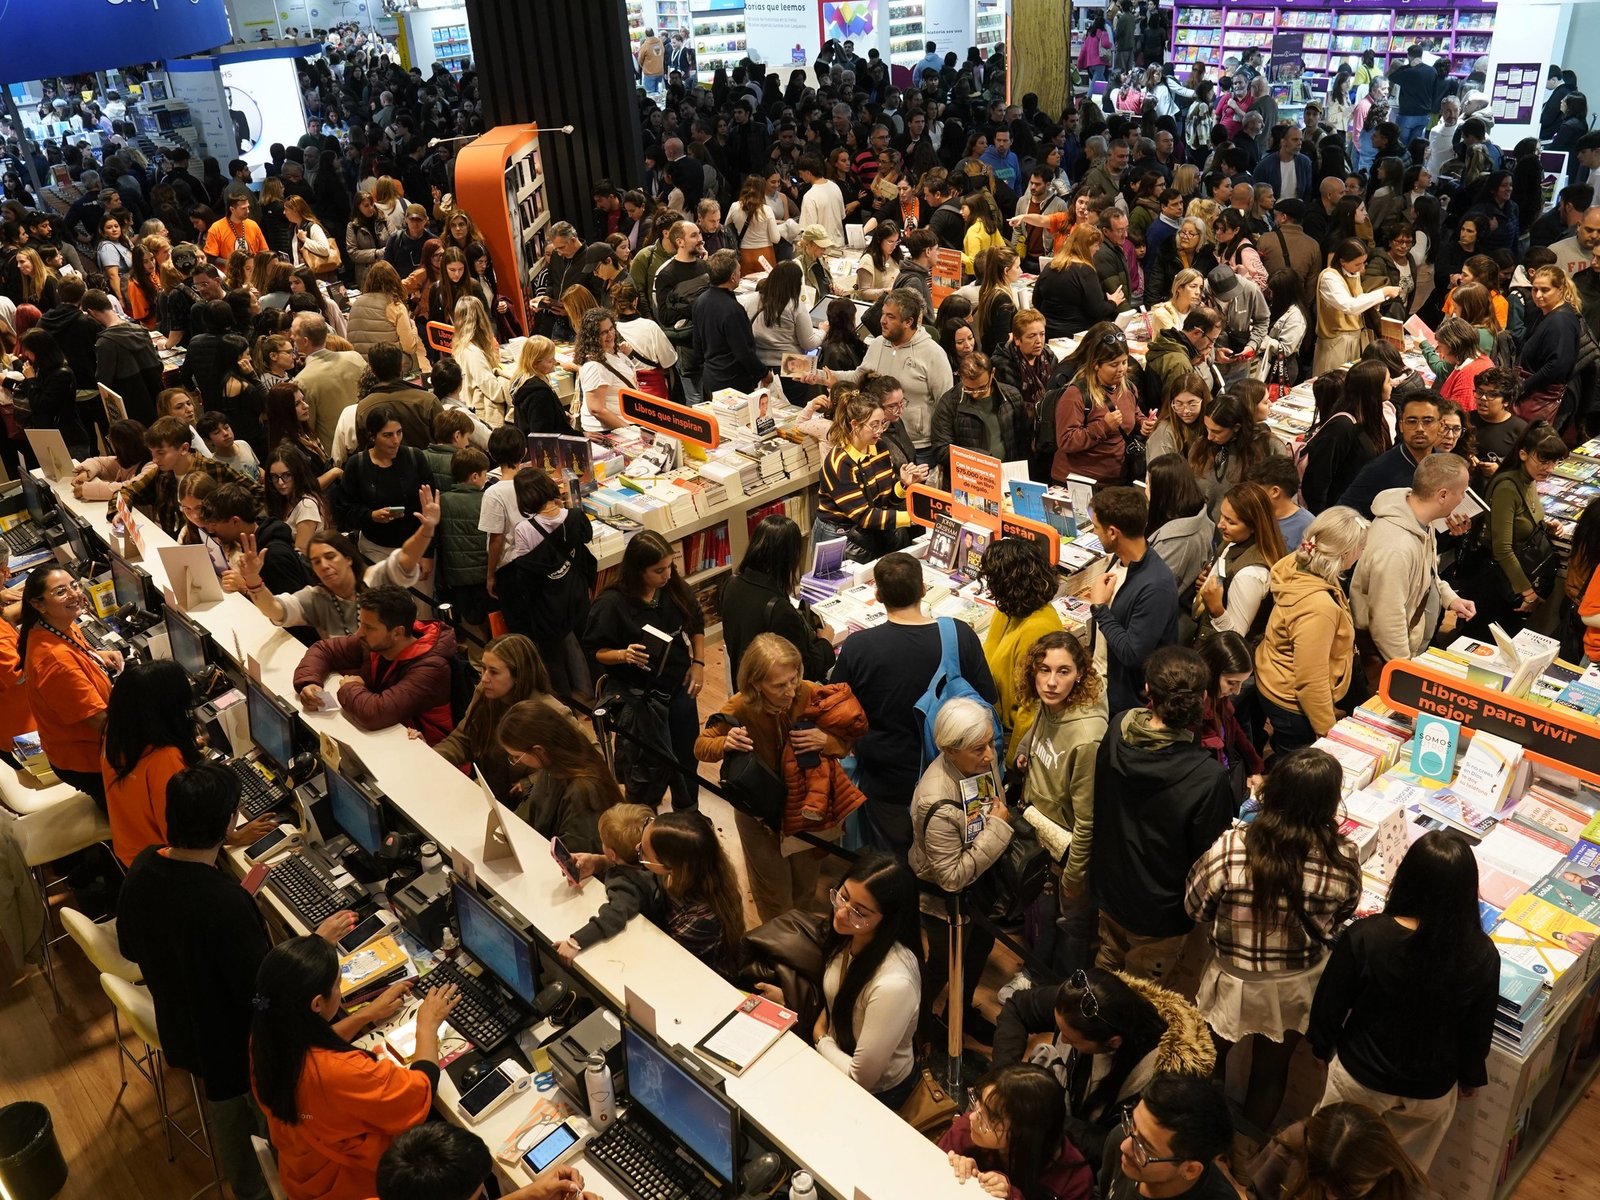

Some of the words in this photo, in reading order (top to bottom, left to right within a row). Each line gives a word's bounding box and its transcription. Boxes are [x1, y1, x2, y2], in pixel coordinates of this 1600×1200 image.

[780, 3, 806, 11] leemos
[634, 402, 656, 417] Libros
[657, 412, 672, 422] que
[672, 414, 703, 433] inspiran
[983, 480, 995, 490] libro
[930, 497, 943, 510] Lo
[941, 517, 956, 528] JOHN
[1418, 697, 1474, 725] mejor
[1421, 680, 1479, 710] Libros
[1482, 703, 1527, 728] para
[1532, 720, 1578, 745] vivir
[1419, 732, 1452, 748] SOMOS
[1479, 768, 1493, 778] crees
[1537, 883, 1554, 897] SOÑAR
